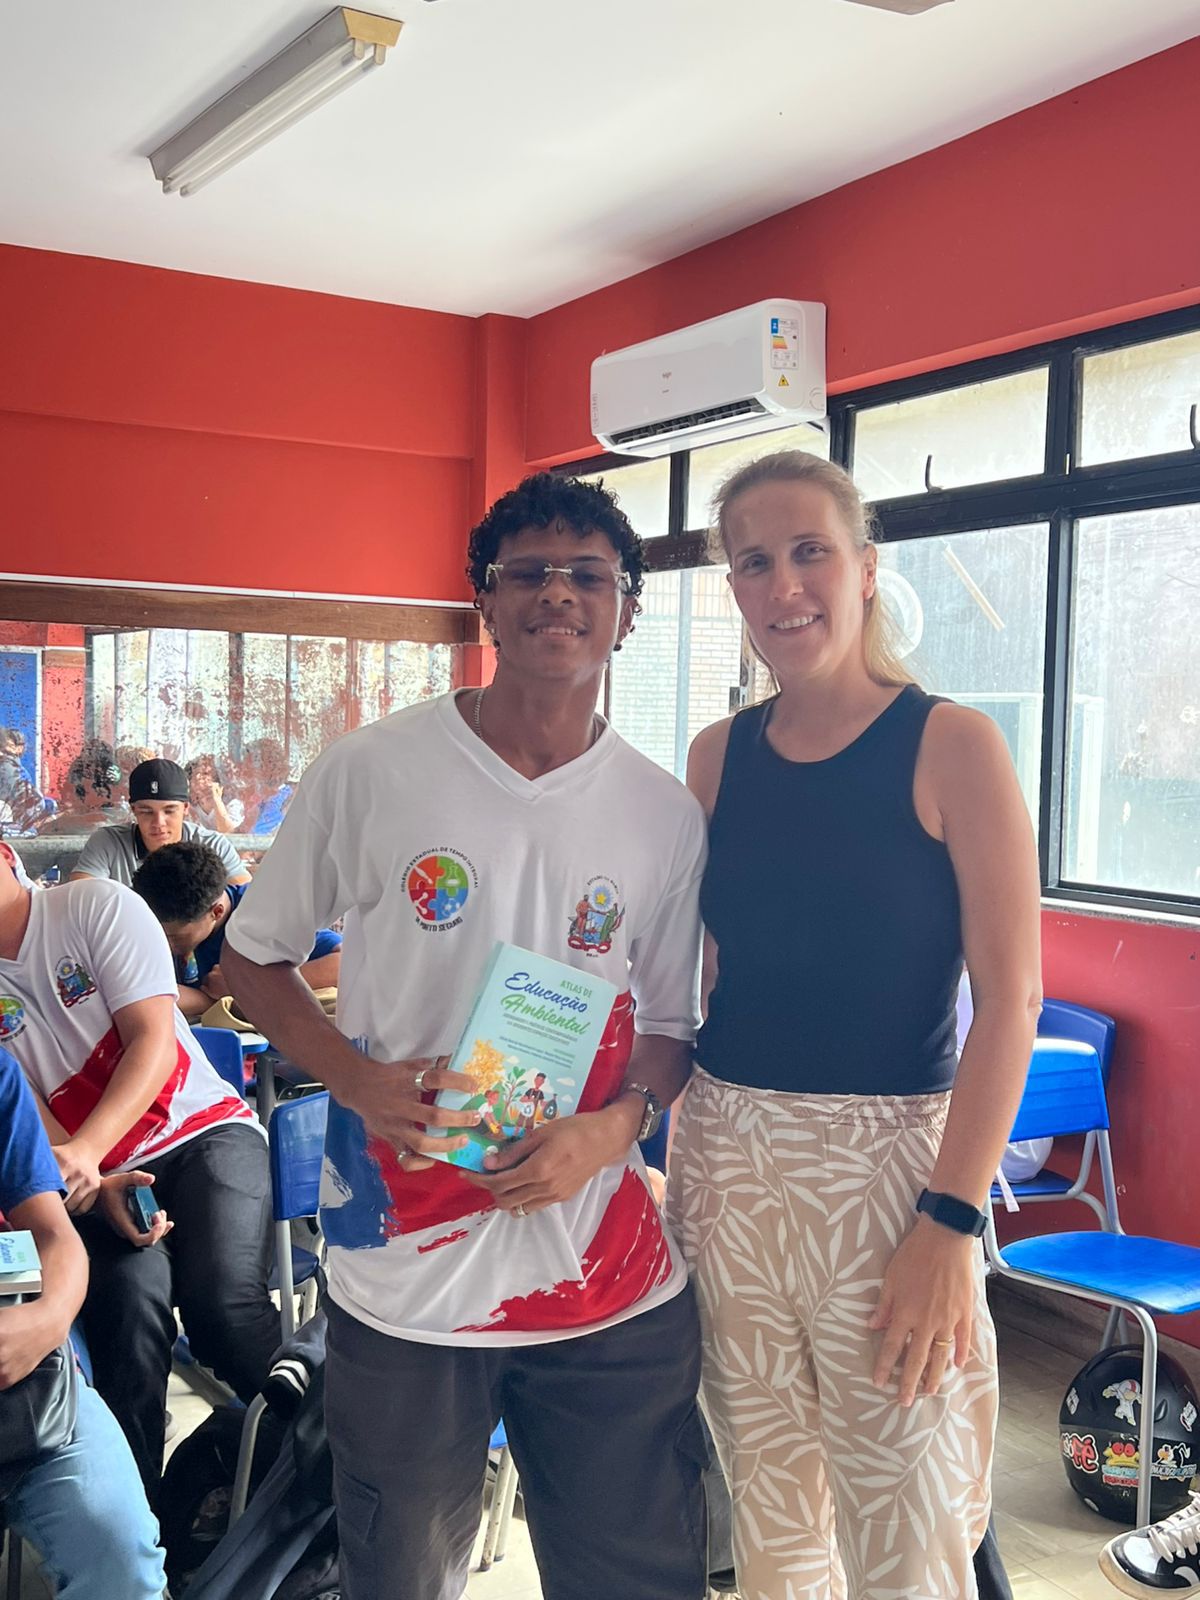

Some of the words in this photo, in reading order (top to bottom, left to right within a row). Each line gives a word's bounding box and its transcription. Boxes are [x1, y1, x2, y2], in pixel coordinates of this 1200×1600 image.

[449, 848, 468, 861] TEMPO
[505, 972, 588, 1013] Educação
[560, 980, 583, 994] ATLAS
[501, 994, 591, 1035] Ambiental
